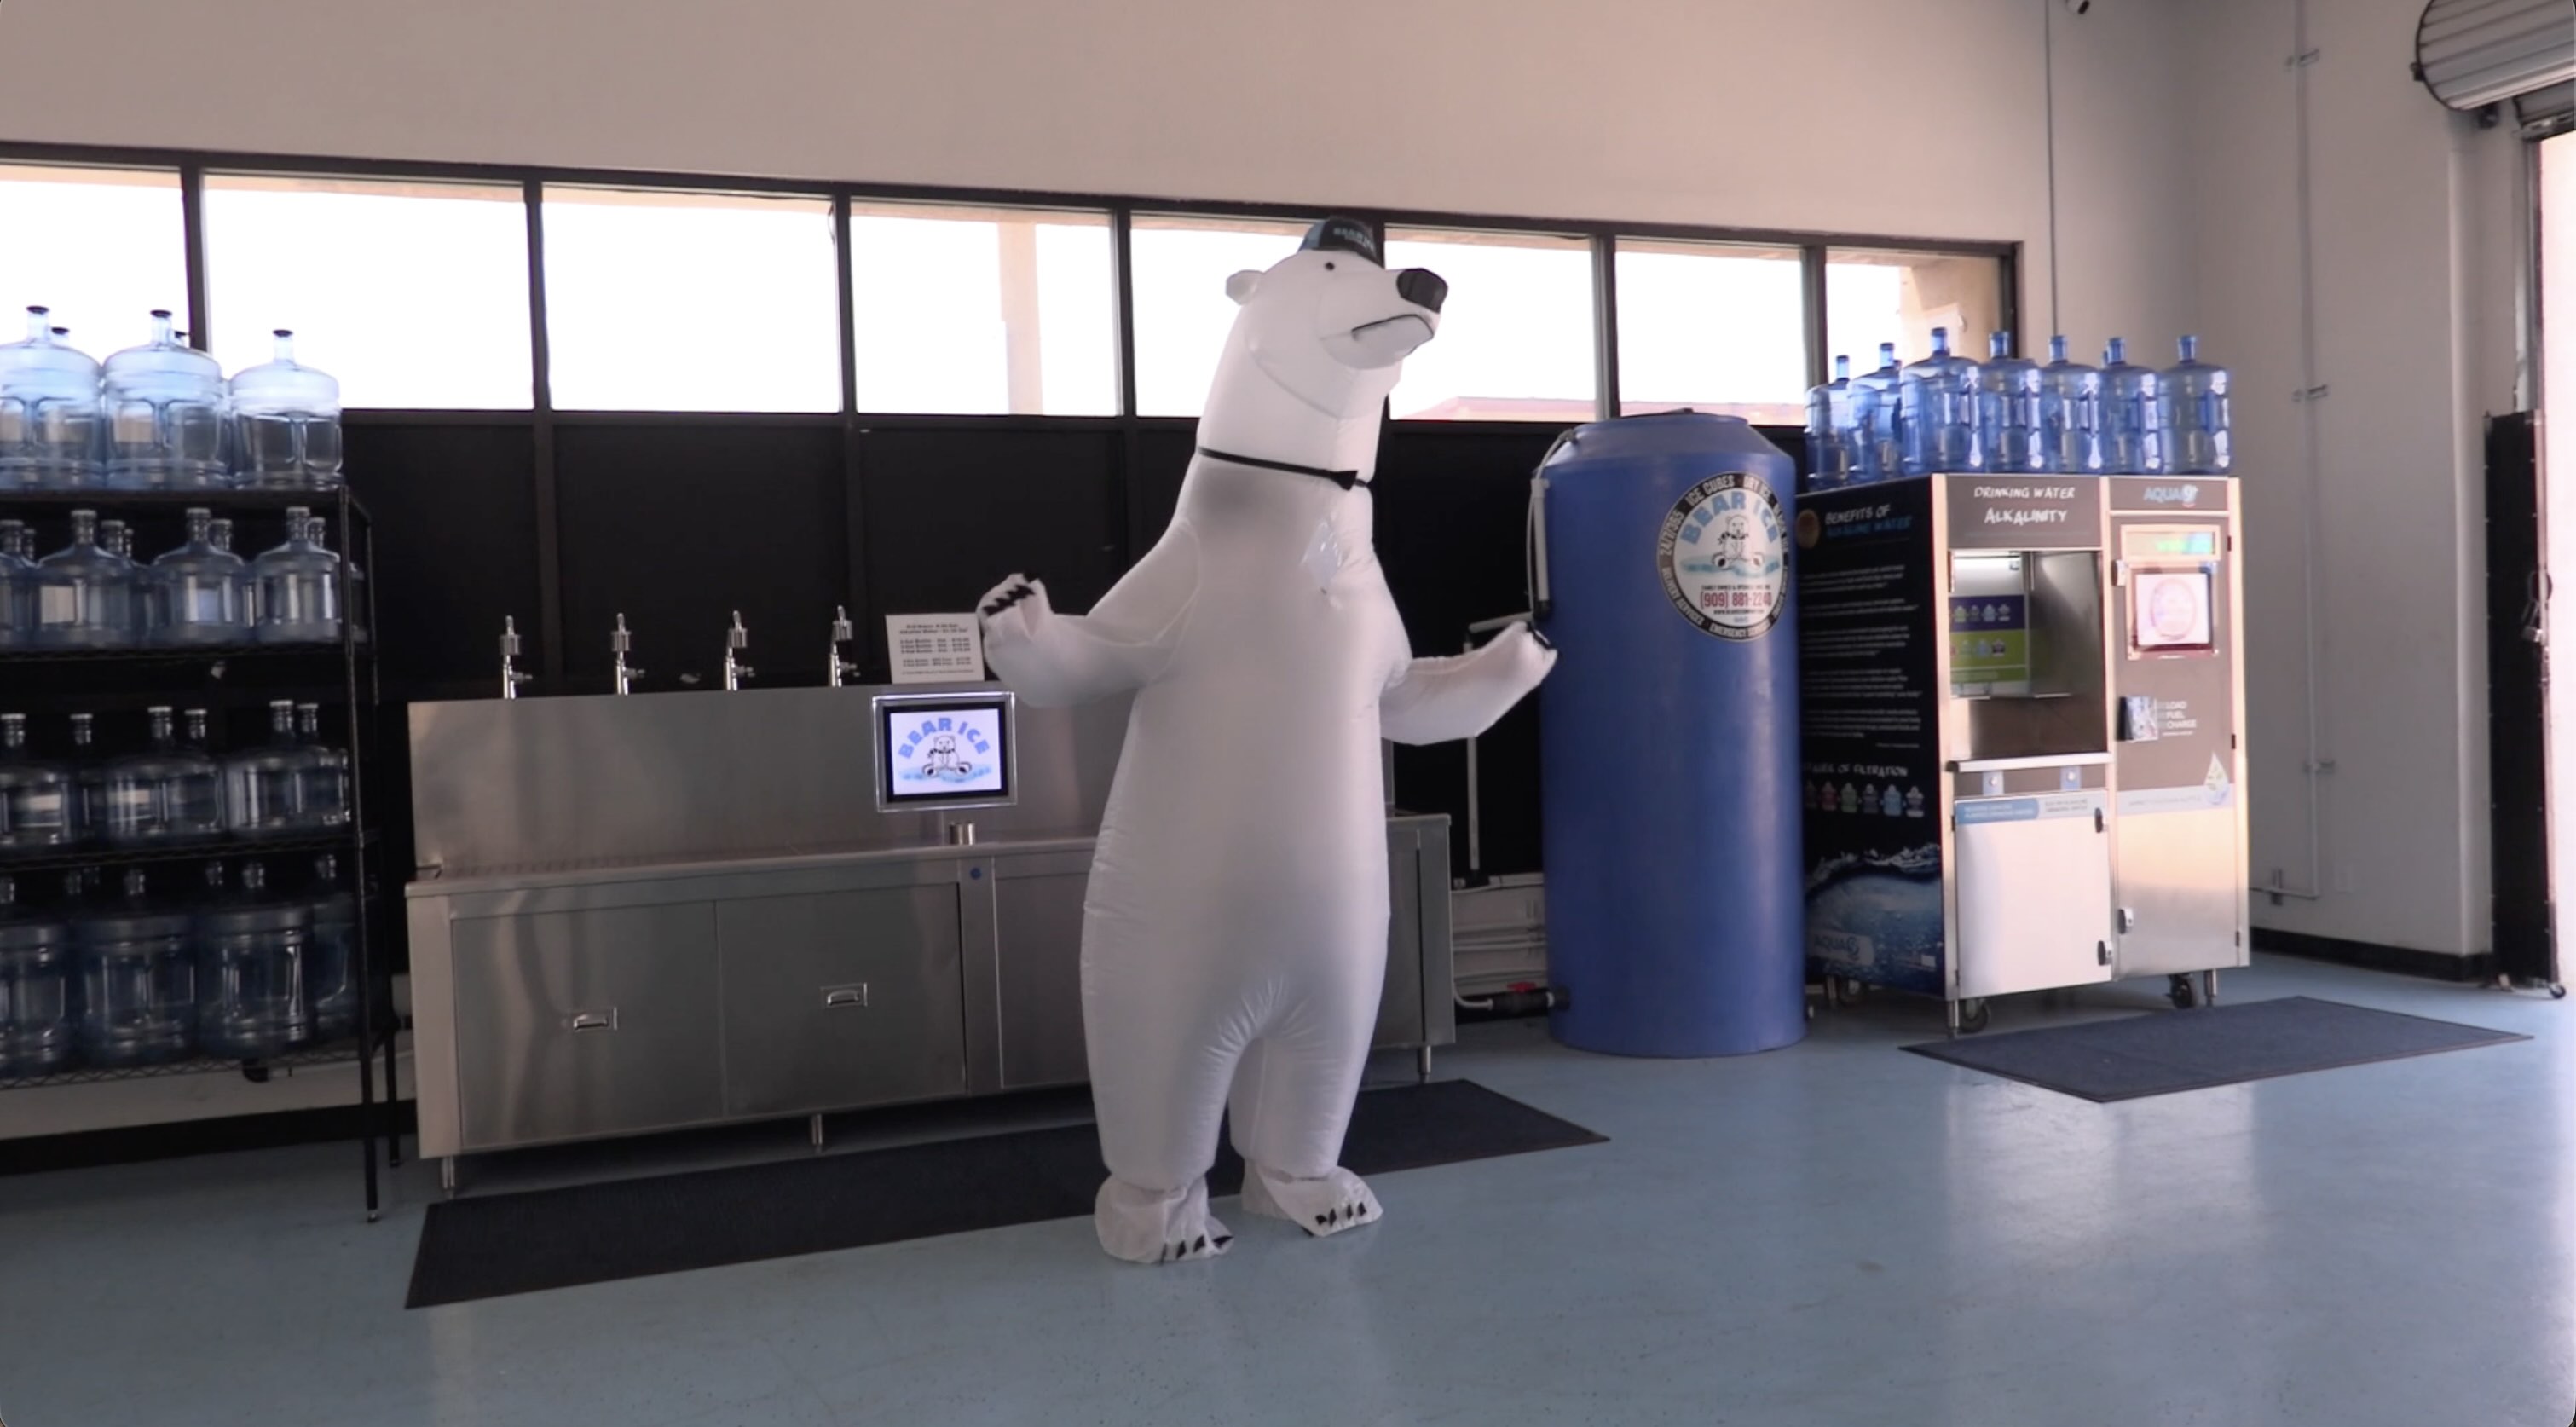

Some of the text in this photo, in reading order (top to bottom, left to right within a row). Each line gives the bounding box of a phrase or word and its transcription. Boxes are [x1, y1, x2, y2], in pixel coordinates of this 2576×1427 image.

[1684, 488, 1705, 506] ICE
[1702, 475, 1736, 495] CUBES
[1974, 487, 2076, 500] DRINKING WATER
[1680, 491, 1746, 546] BEAR
[1753, 499, 1779, 543] ICE
[1825, 505, 1890, 524] BENEFITS OF
[1984, 507, 2068, 525] ALKALINITY
[1701, 590, 1729, 610] (909)
[898, 718, 991, 760] BEAR ICE
[1853, 765, 1909, 777] FILTRATION
